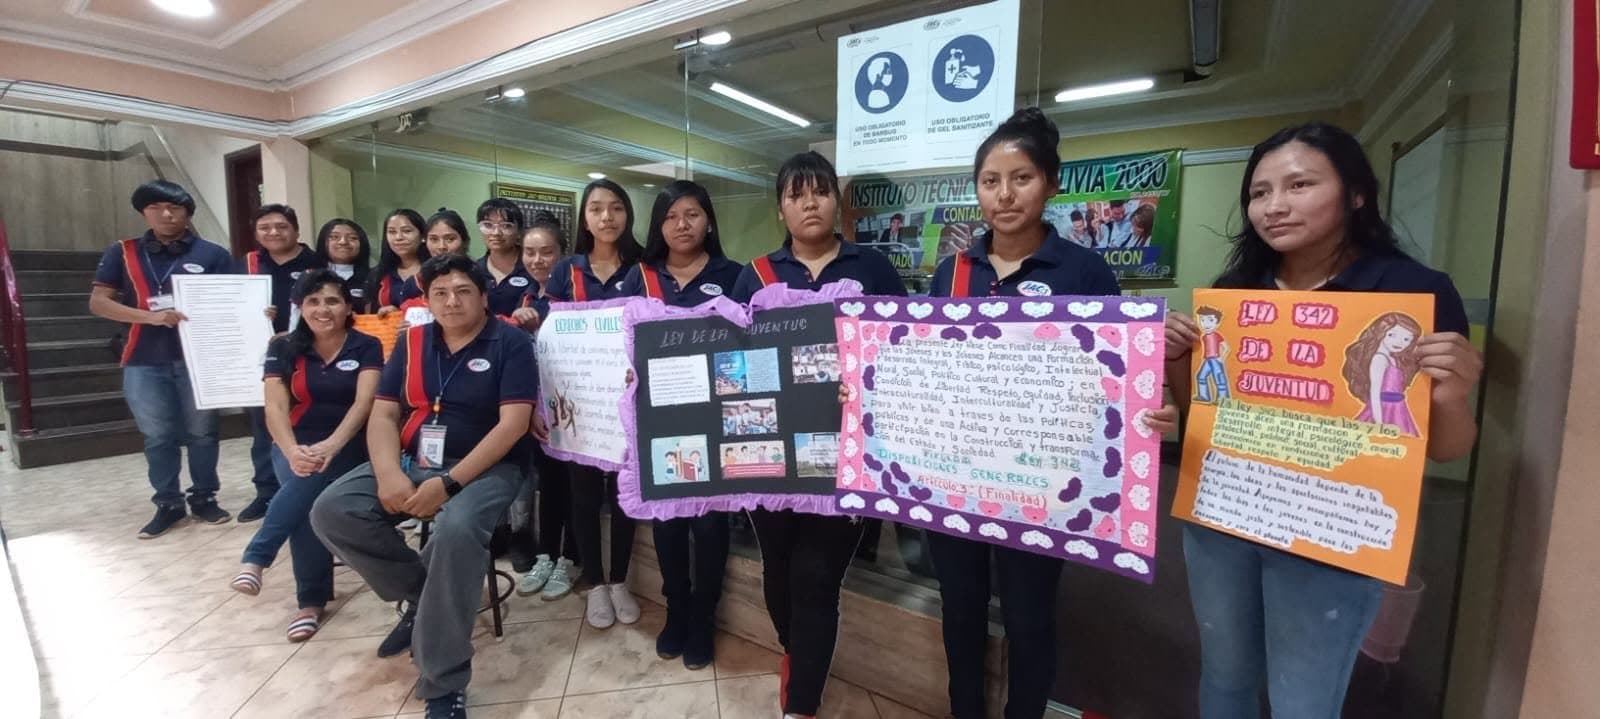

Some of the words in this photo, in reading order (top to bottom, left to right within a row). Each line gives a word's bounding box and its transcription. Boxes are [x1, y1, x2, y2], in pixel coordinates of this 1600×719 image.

[946, 113, 990, 124] OBLIGATORIO
[868, 120, 906, 131] OBLIGATORIO
[951, 120, 993, 132] SANITIZANTE
[878, 134, 908, 144] MOMENTO
[850, 181, 917, 208] INSTITUTO
[921, 178, 977, 204] TECNIC
[1058, 163, 1106, 196] LIVIA
[1111, 158, 1168, 192] 2000
[943, 206, 983, 222] CONTAD
[1244, 301, 1273, 321] LEY
[1297, 306, 1330, 324] 342
[1243, 340, 1265, 358] DE
[1294, 344, 1317, 363] LA
[1079, 381, 1095, 390] en
[999, 411, 1012, 422] de
[1237, 400, 1251, 412] ley
[1282, 409, 1312, 422] busca
[1317, 417, 1337, 428] que
[1342, 416, 1360, 430] las
[1380, 424, 1398, 437] los
